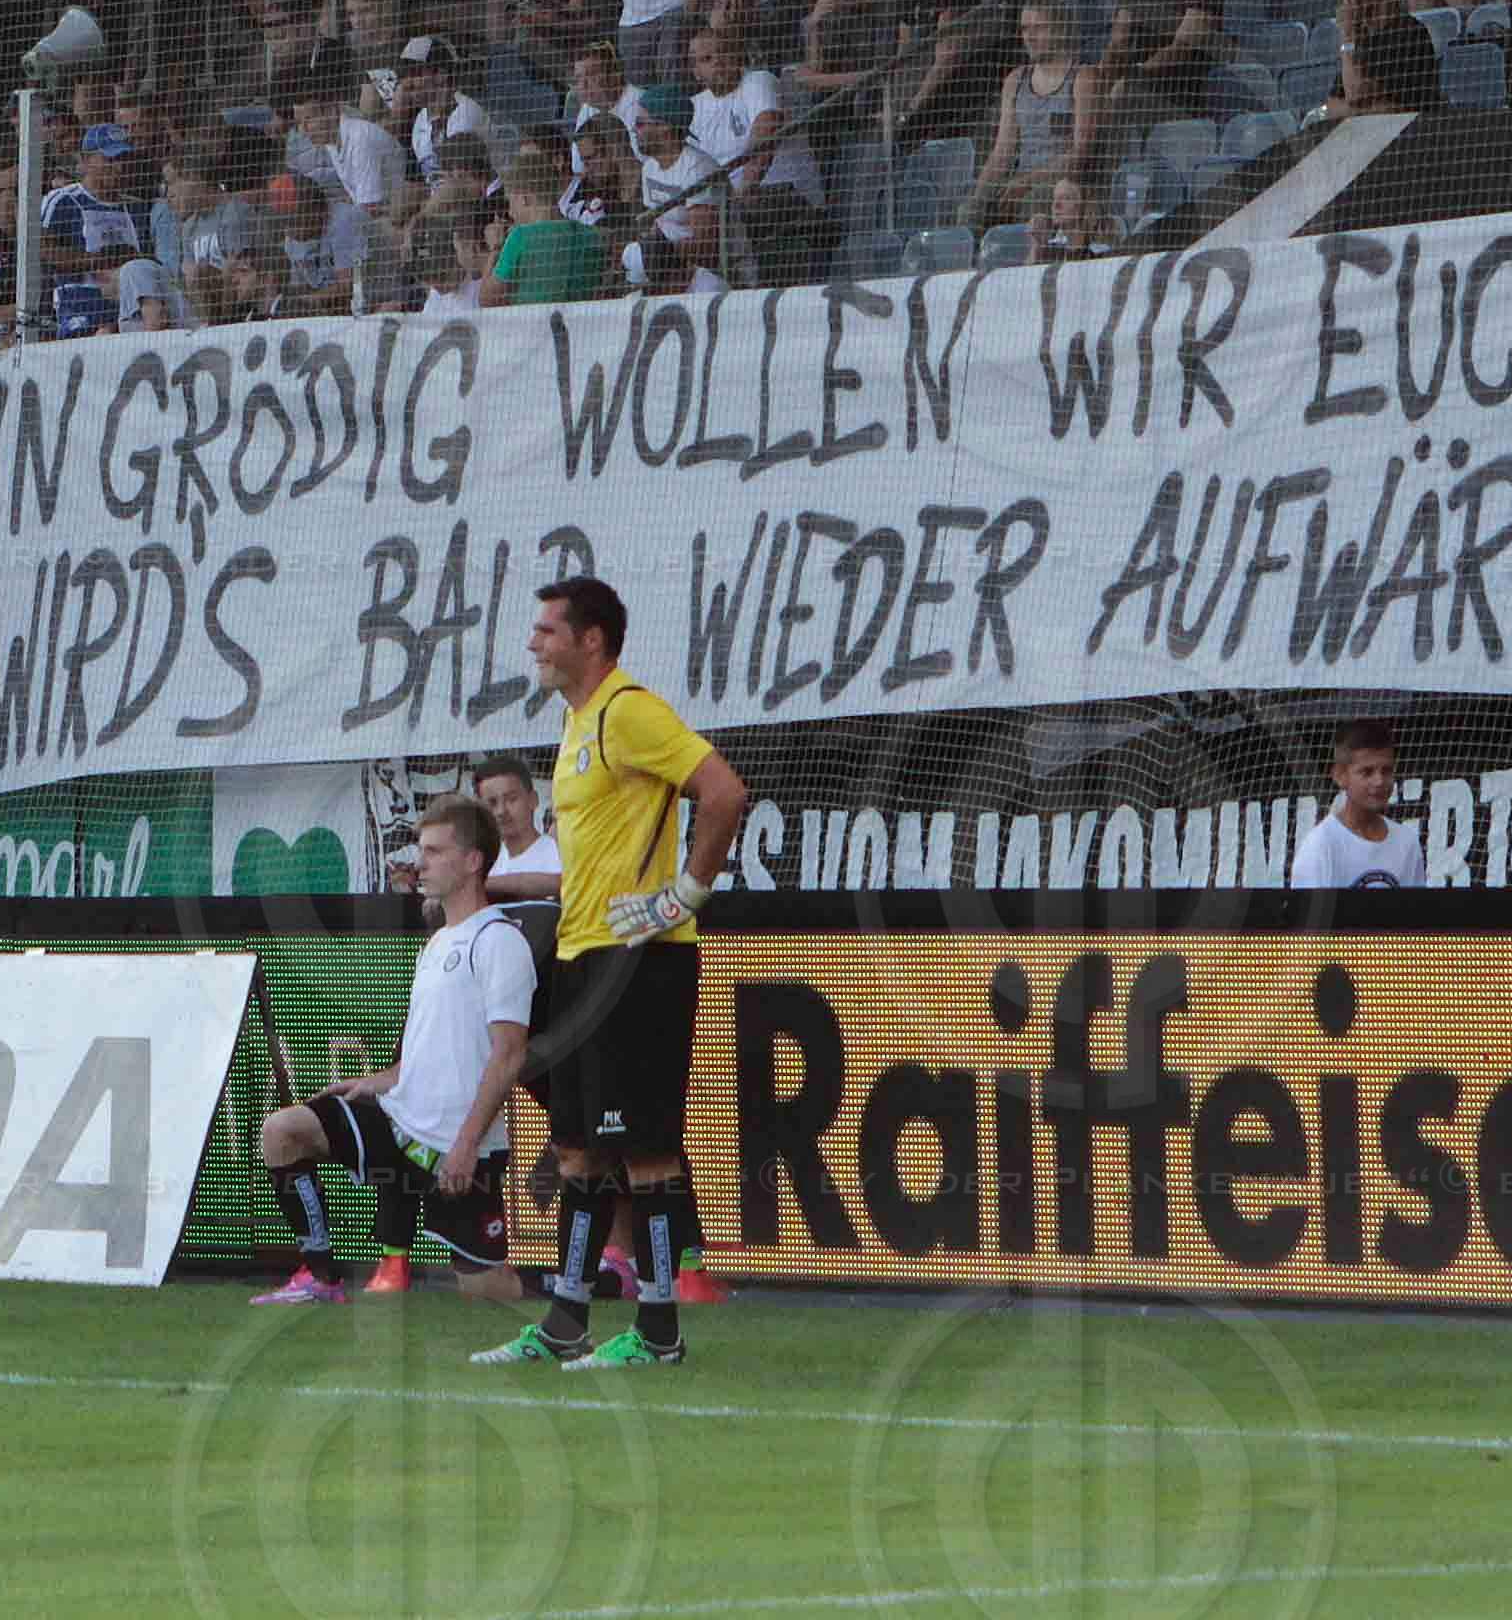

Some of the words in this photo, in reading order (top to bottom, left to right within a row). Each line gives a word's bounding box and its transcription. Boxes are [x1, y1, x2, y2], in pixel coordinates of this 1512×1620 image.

[99, 317, 479, 533] GRÖDIG
[551, 265, 986, 481] WOLLEN
[1038, 249, 1252, 440] WIR
[690, 497, 1049, 709] WIEDER
